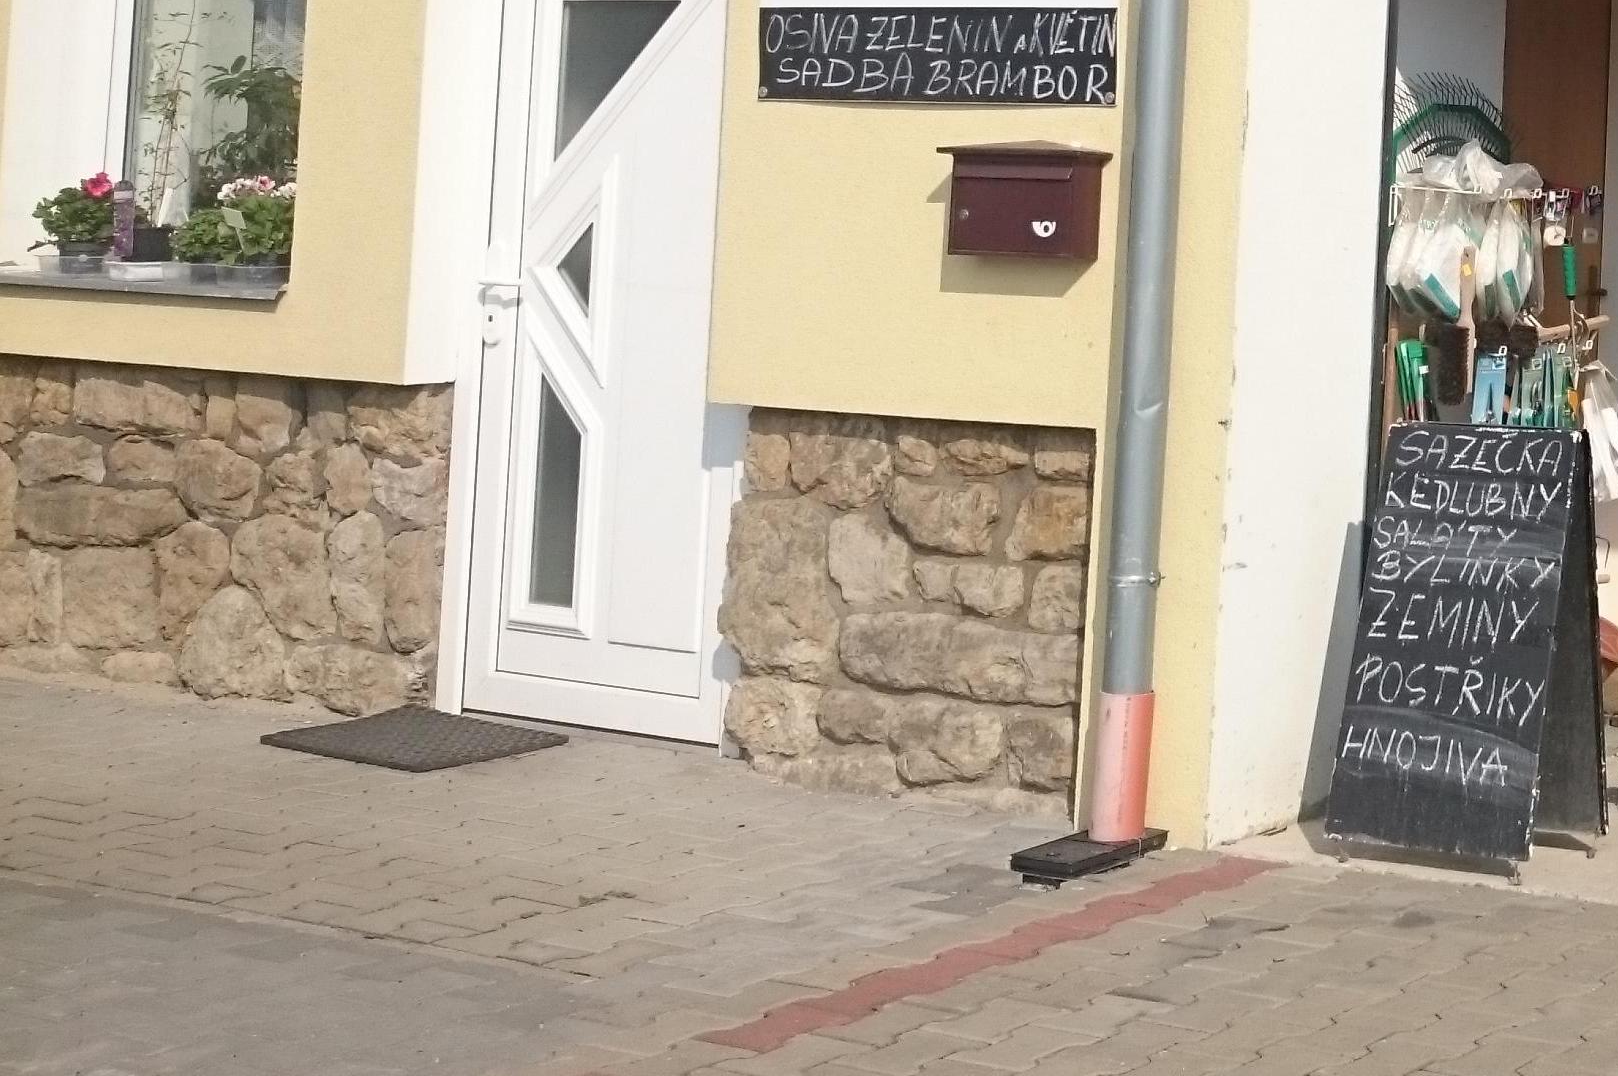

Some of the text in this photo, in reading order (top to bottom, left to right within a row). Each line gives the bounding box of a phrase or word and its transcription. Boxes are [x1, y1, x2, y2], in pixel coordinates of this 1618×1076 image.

[766, 12, 859, 54] OSIVA
[865, 13, 1013, 55] ZELENIN
[776, 52, 1109, 104] SADBA BRAMBOR
[1395, 430, 1563, 477] SAZEČKA
[1384, 471, 1562, 524] KEDLUBNY
[1371, 549, 1556, 593] BYLINKY
[1367, 586, 1539, 651] ZEMINY
[1355, 652, 1546, 727] POSTŘIKY
[1340, 725, 1508, 787] HNOJIVA
